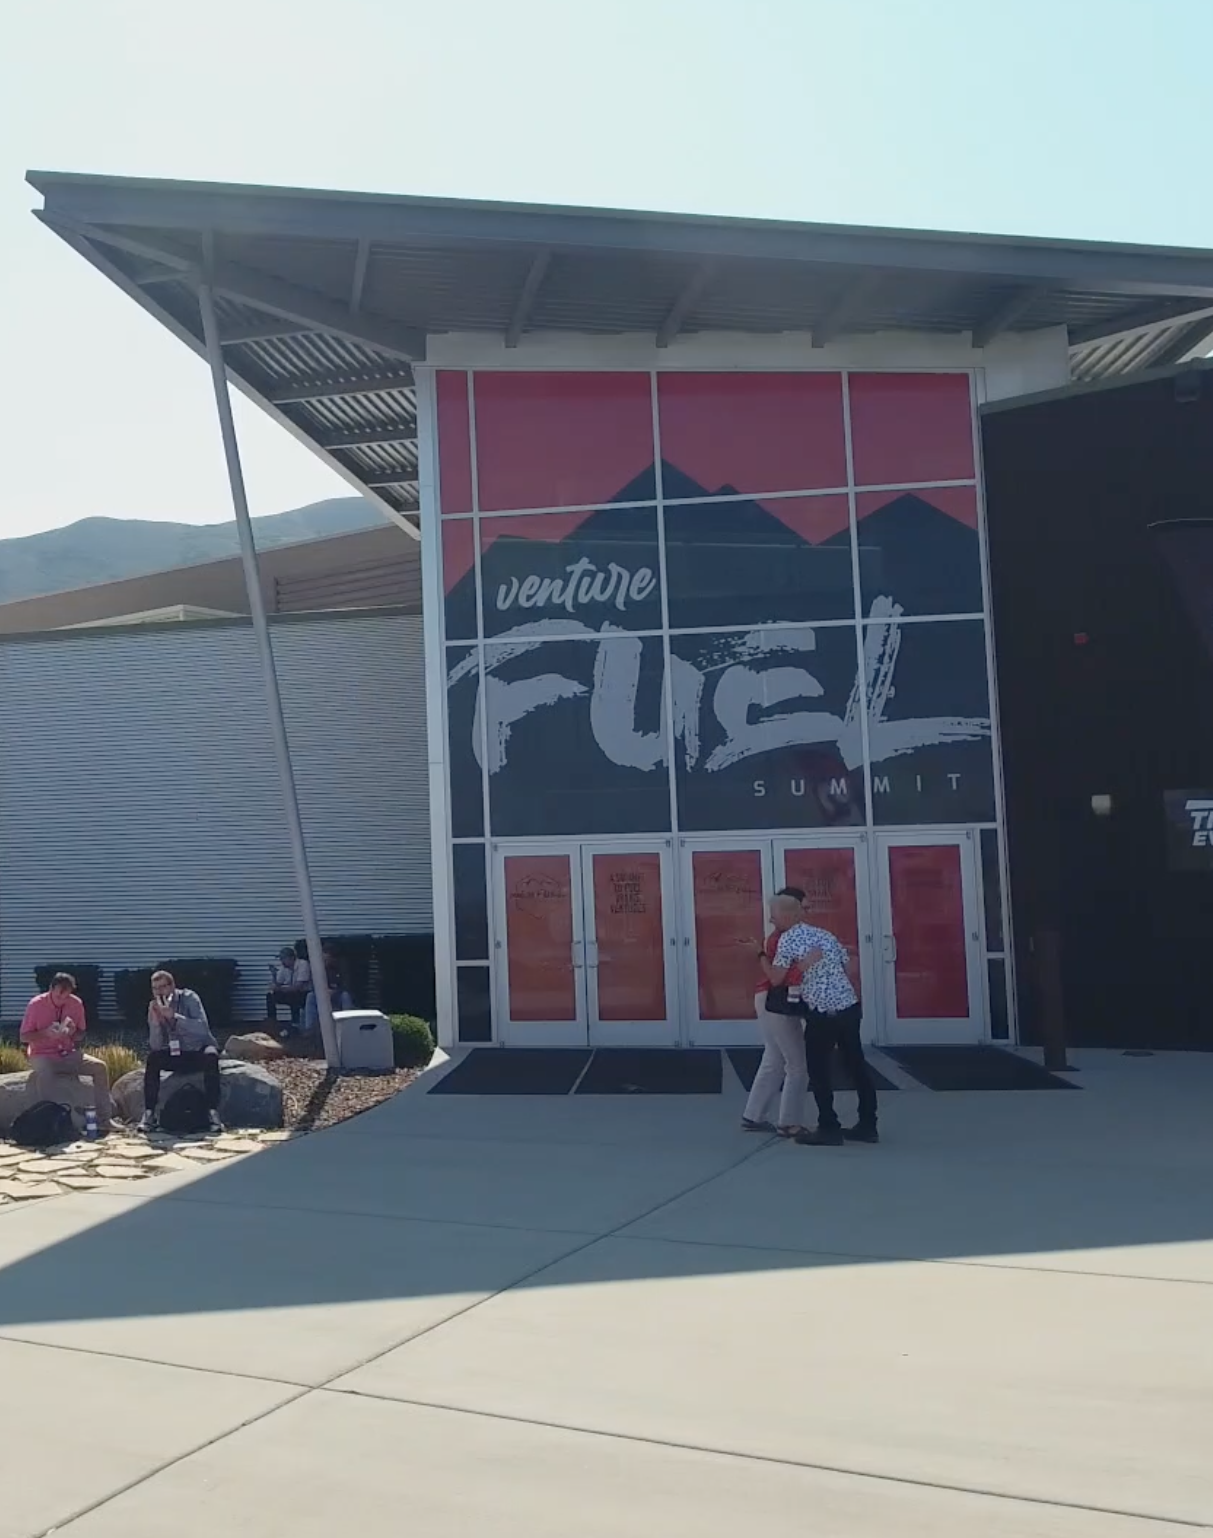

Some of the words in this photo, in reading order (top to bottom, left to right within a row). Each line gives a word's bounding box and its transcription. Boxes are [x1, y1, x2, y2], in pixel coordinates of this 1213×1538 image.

[496, 557, 656, 612] venture
[446, 594, 992, 774] FUEL
[753, 773, 961, 797] SUMMIT
